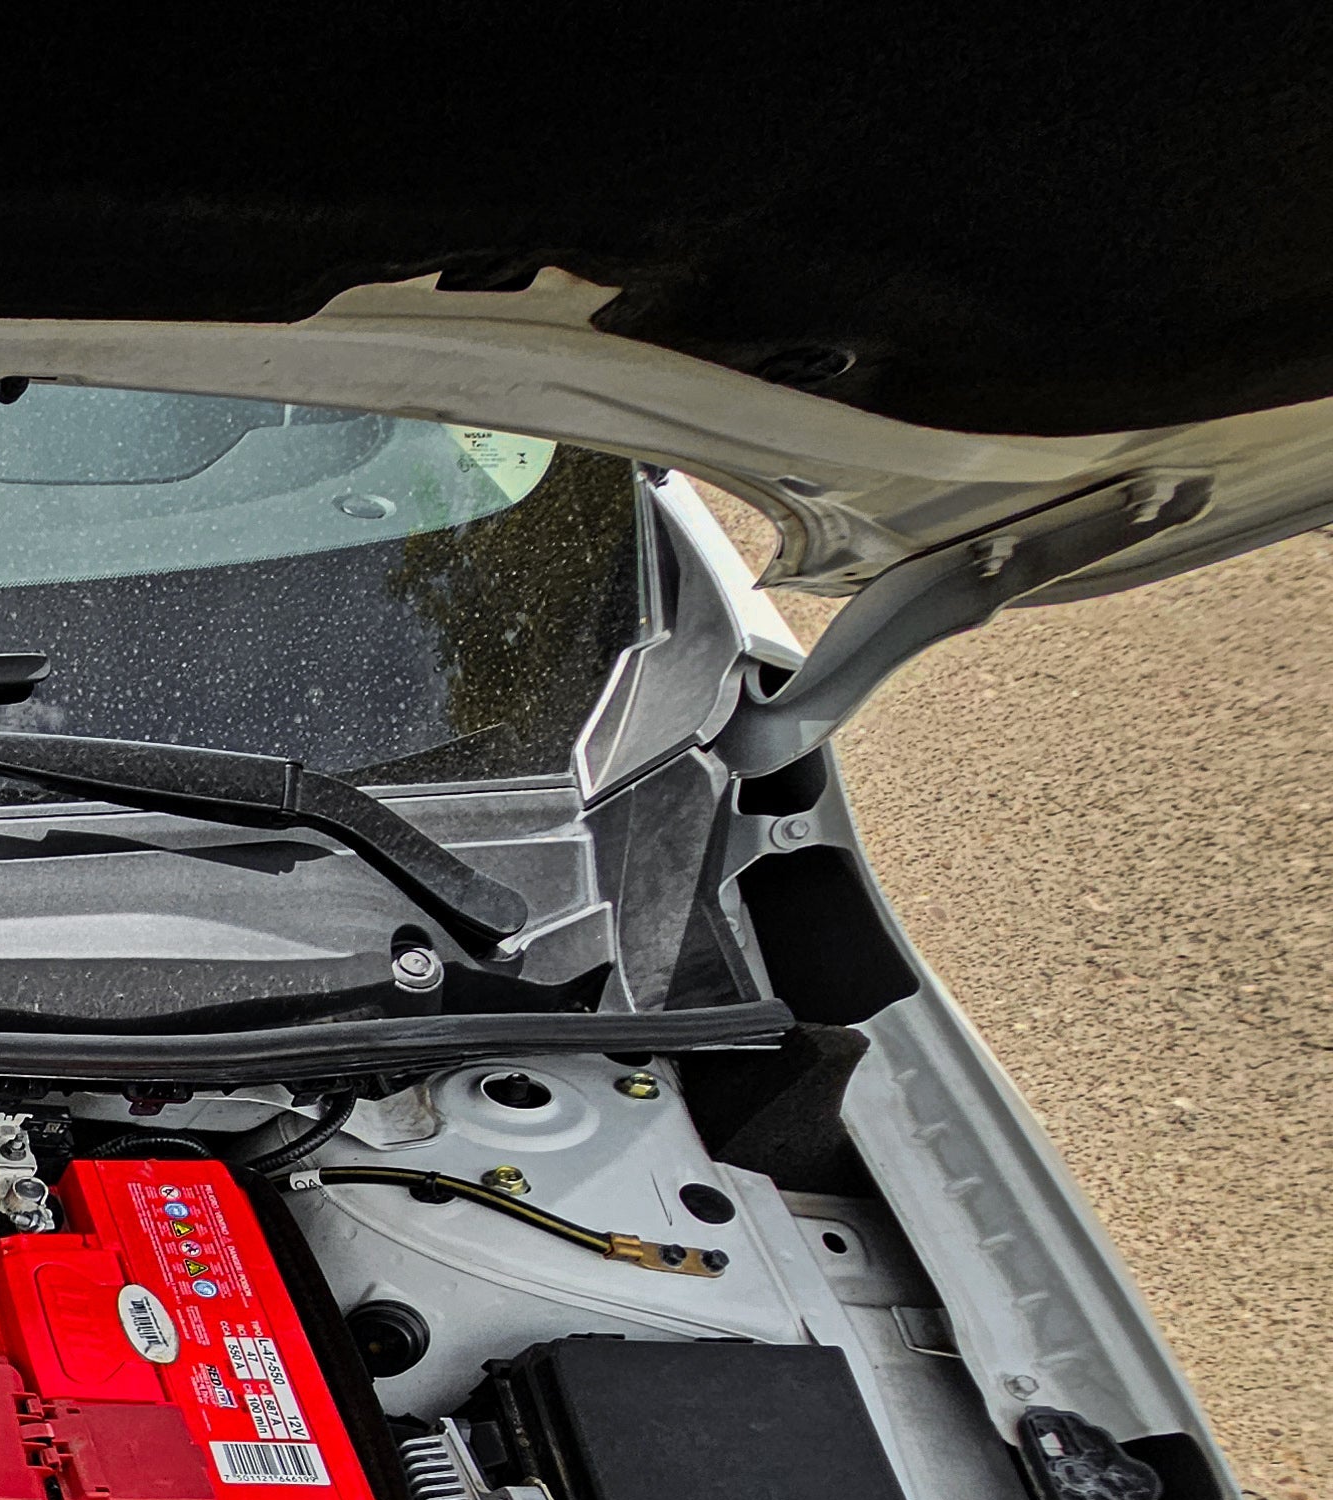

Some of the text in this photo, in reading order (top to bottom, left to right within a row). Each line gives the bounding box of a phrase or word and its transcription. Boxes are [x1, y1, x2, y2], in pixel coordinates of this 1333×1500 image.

[228, 1344, 242, 1360] 550
[248, 1398, 262, 1414] 100
[246, 1351, 258, 1362] 47
[264, 1399, 278, 1416] 687
[258, 1339, 285, 1385] L-47-550
[287, 1415, 306, 1437] 12V
